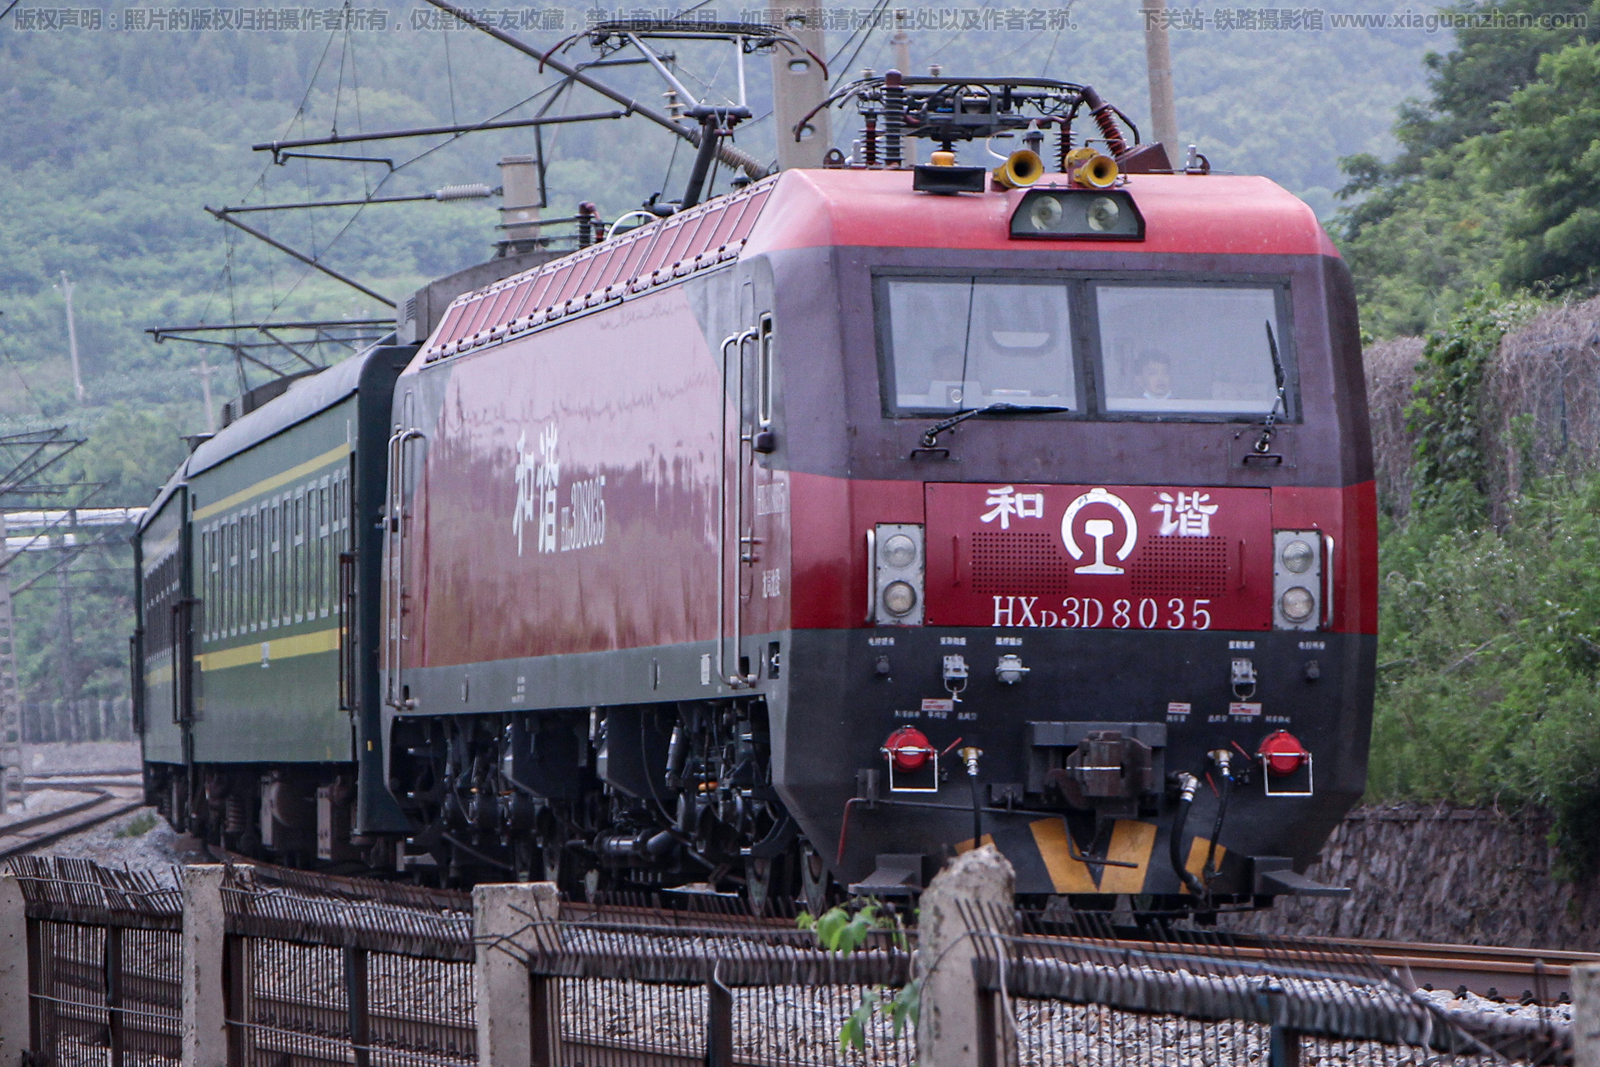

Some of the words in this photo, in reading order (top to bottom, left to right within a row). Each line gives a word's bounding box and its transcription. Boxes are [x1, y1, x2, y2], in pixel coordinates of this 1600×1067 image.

[512, 421, 560, 558] 和谐
[979, 485, 1045, 530] 和
[1150, 490, 1219, 537] 谐
